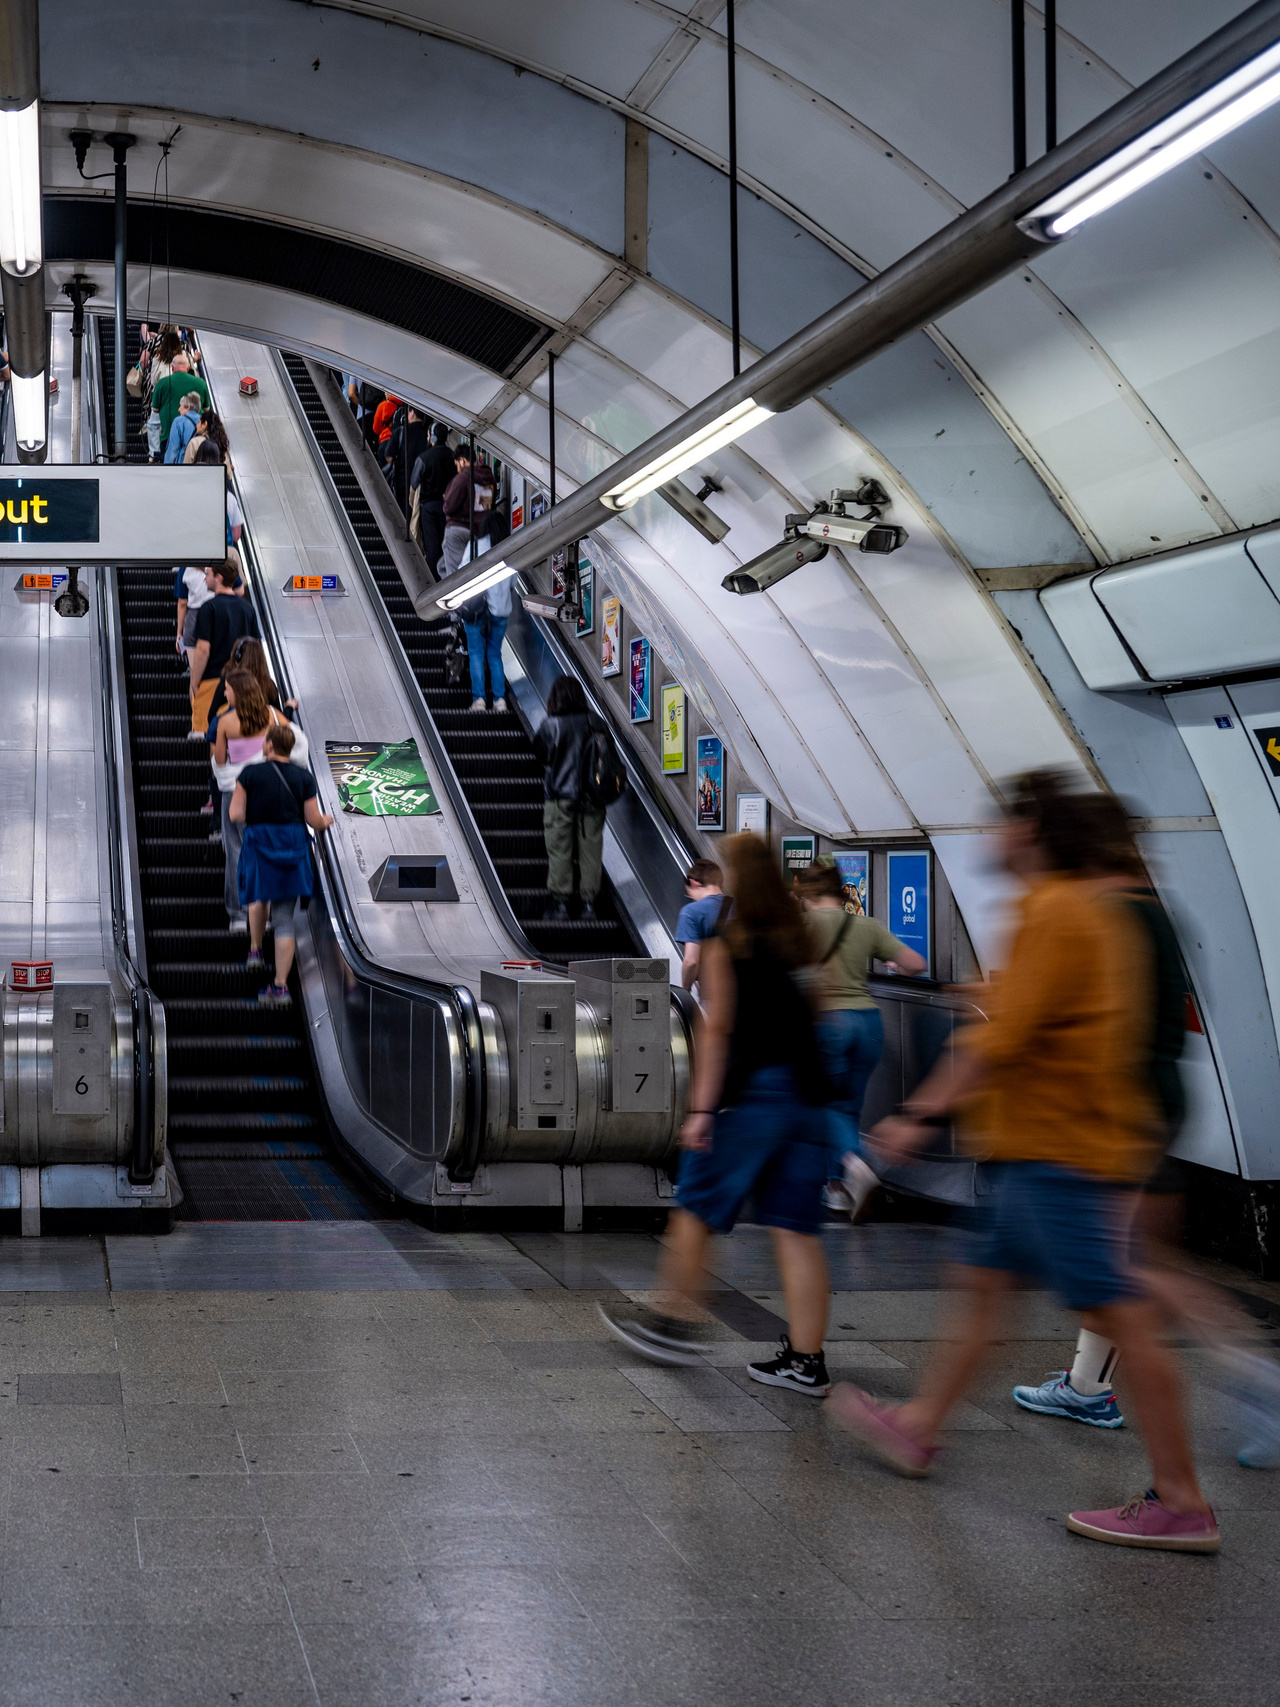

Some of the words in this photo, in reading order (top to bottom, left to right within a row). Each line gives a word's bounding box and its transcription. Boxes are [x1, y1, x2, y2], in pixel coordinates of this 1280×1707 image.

[343, 763, 403, 784] HANDRAIL
[340, 772, 430, 805] HOLD
[902, 914, 916, 925] global
[15, 969, 27, 977] STOP
[36, 969, 50, 977] STOP
[75, 1075, 89, 1095] 6
[634, 1073, 649, 1093] 7
